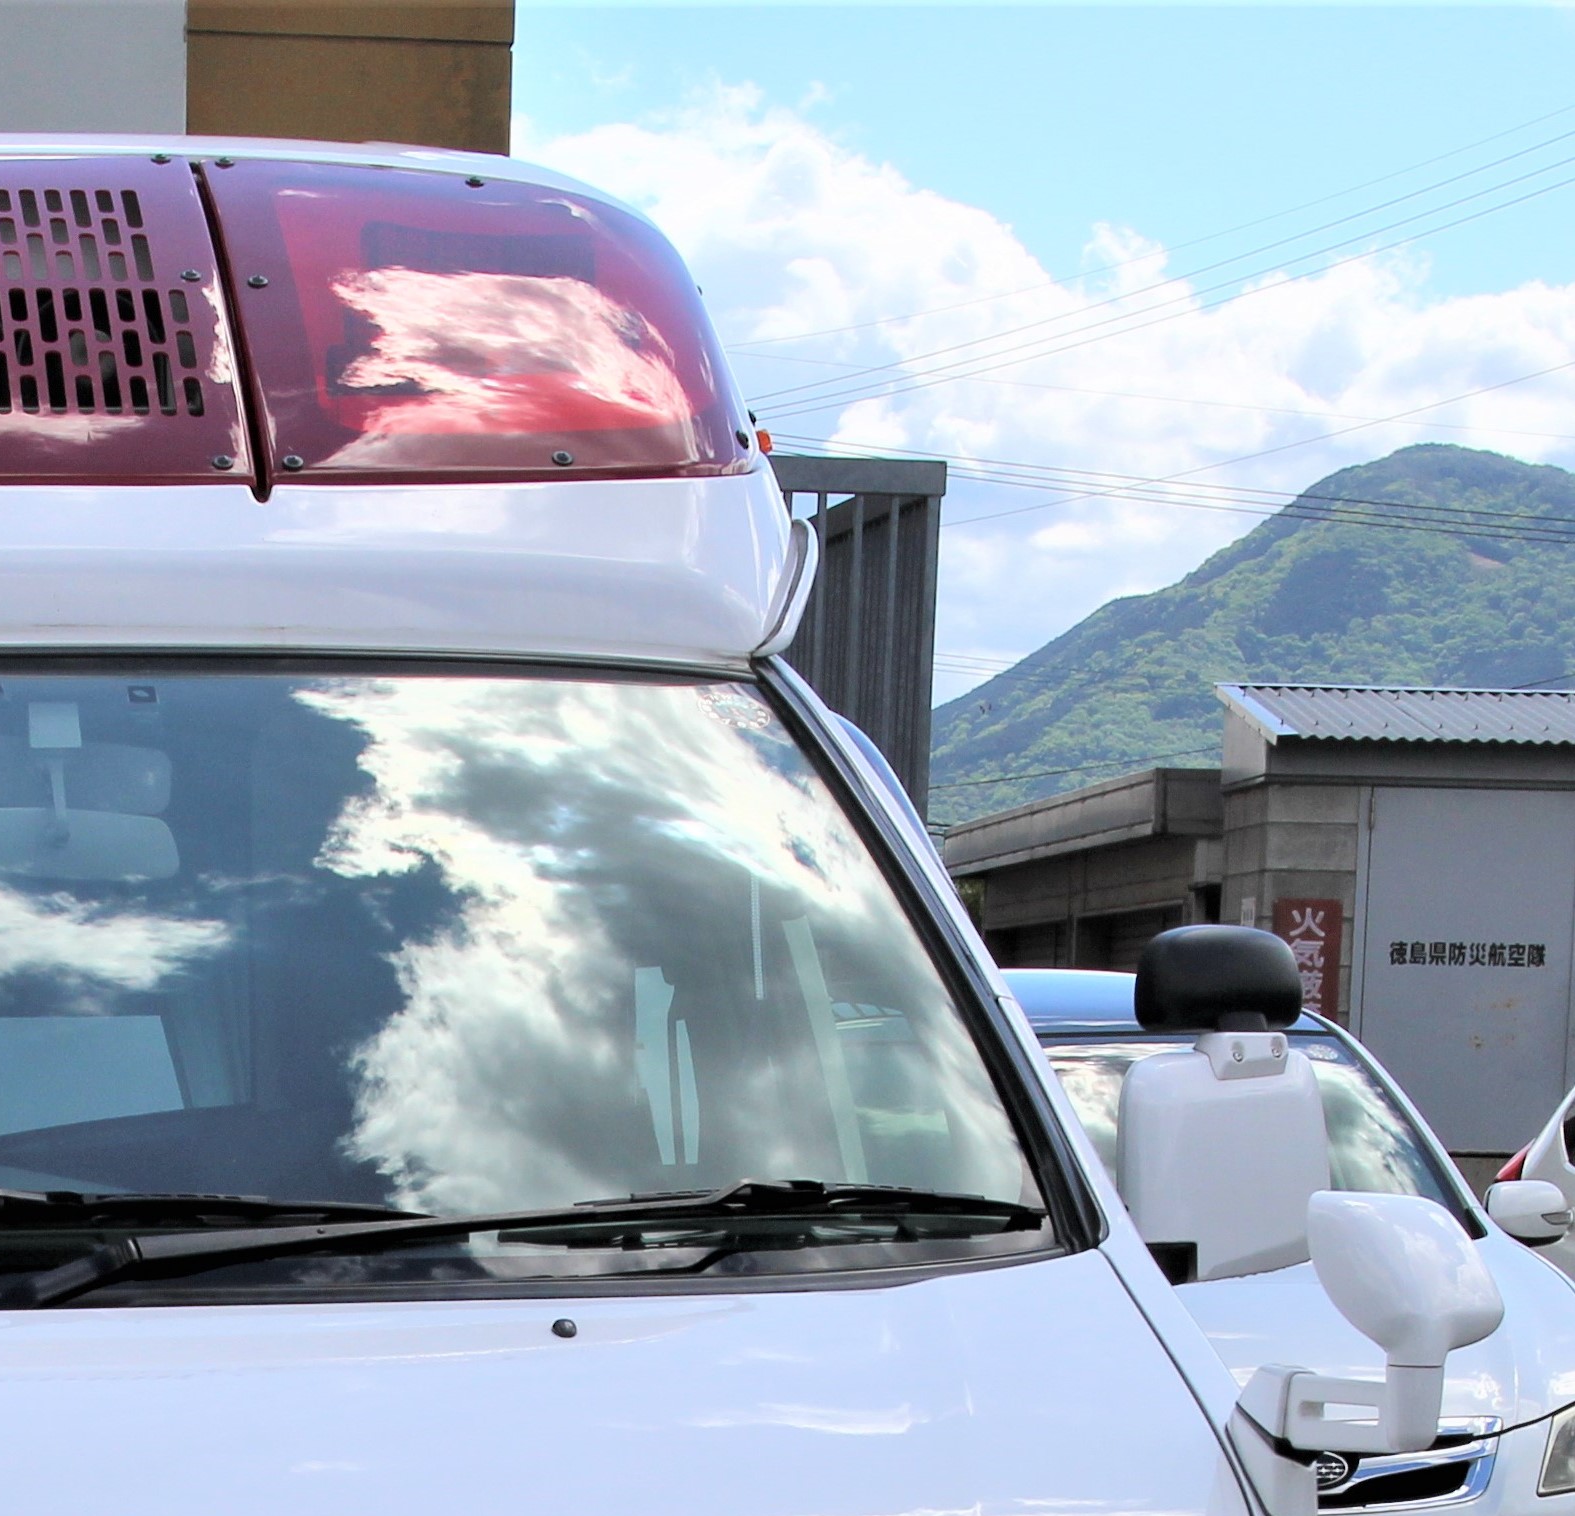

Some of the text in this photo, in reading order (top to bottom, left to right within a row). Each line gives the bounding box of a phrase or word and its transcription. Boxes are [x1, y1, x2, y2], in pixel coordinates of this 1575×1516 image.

[1389, 940, 1547, 968] 徳島県防災航空隊
